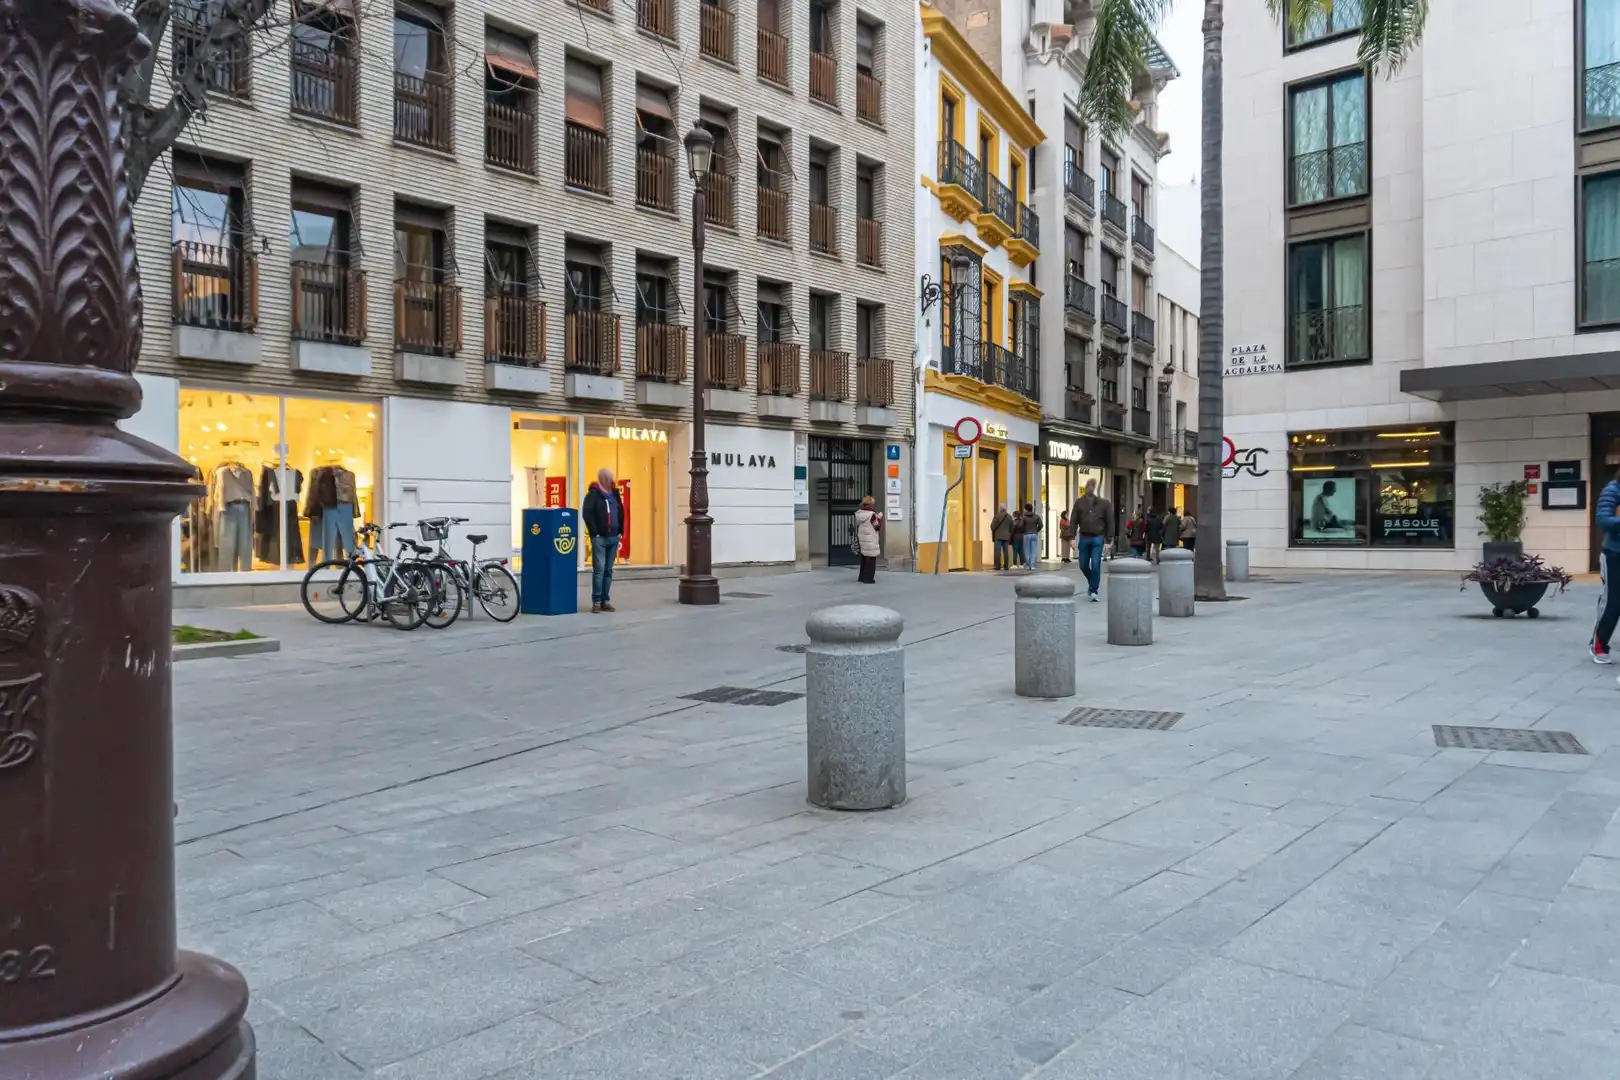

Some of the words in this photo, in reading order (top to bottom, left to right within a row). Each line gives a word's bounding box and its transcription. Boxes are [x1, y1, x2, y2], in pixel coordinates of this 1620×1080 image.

[1231, 344, 1266, 354] PLAZA
[1231, 356, 1245, 365] DE
[1253, 354, 1267, 363] LA
[1224, 363, 1282, 376] AGDALENA
[608, 426, 668, 443] MULAYA
[711, 452, 777, 468] MULAYA
[1383, 519, 1440, 528] BASQUE
